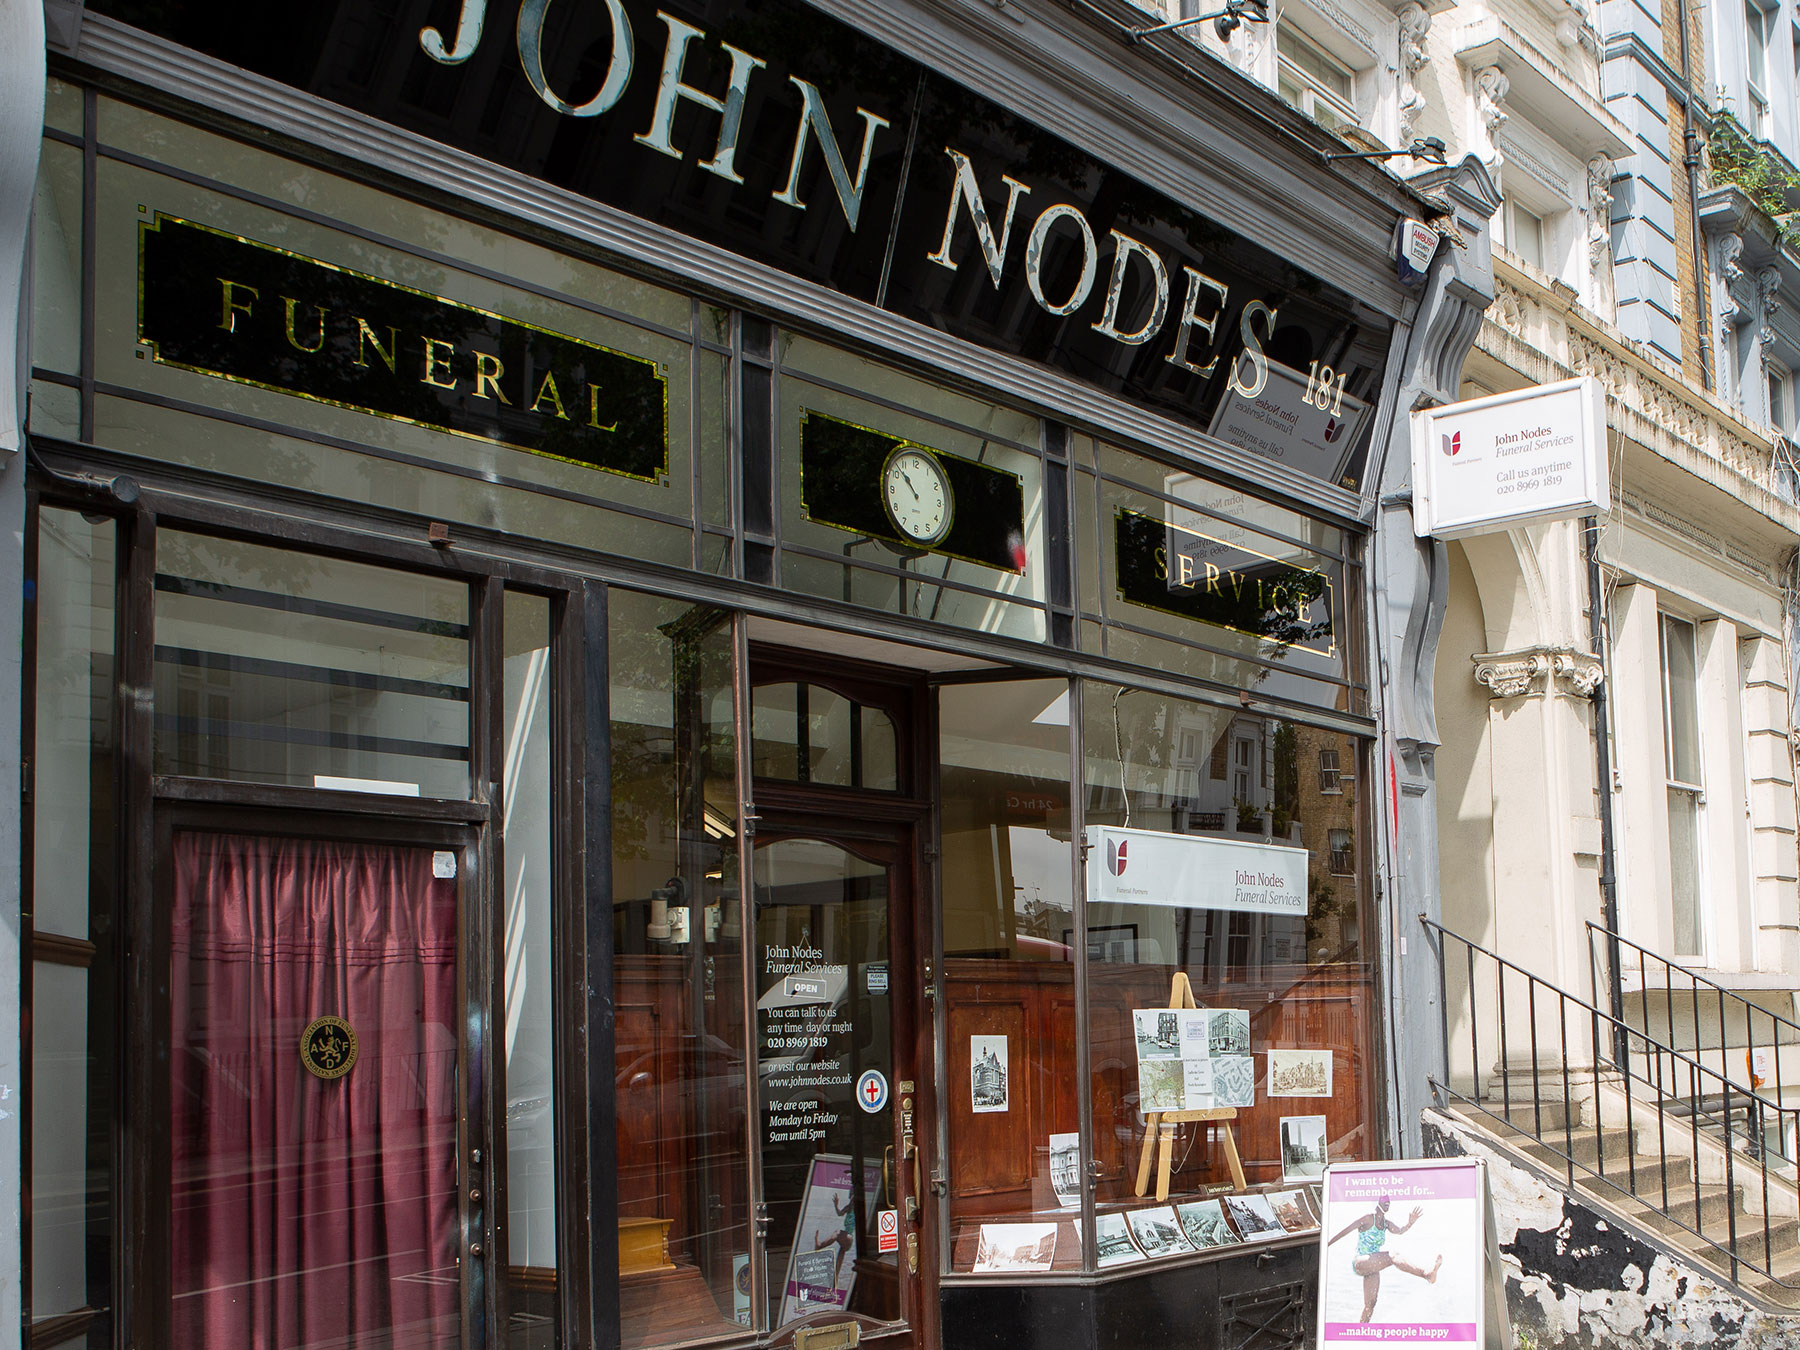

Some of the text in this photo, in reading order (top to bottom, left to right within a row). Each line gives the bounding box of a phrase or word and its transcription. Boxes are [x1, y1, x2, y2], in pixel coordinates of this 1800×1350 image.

[1414, 230, 1436, 247] AMBUSH
[926, 146, 1279, 399] NODES
[1302, 360, 1347, 418] 181
[216, 277, 619, 433] FUNERAL
[1495, 426, 1552, 447] John Nodes
[1496, 434, 1574, 458] Funeral Services
[912, 459, 919, 469] 12
[892, 470, 899, 479] 10
[1496, 460, 1572, 483] Call us anytime
[890, 485, 895, 494] 9
[934, 482, 938, 491] 2
[1496, 475, 1562, 496] 020 8969 1819
[894, 503, 898, 511] 8
[937, 499, 942, 508] 3
[902, 517, 907, 525] 7
[914, 525, 919, 533] 6
[925, 524, 930, 532] 5
[1154, 546, 1312, 624] SERVICE
[1235, 870, 1284, 888] John Nodes
[1235, 888, 1302, 907] Funeral Services
[766, 945, 823, 960] John Nodes
[766, 960, 842, 974] Funeral Services
[794, 983, 818, 993] OPEN
[767, 1007, 836, 1018] You can talk to us
[325, 1026, 333, 1035] N
[767, 1024, 783, 1035] any
[784, 1022, 802, 1033] time
[806, 1022, 820, 1035] day
[832, 1021, 853, 1034] night
[311, 1042, 349, 1053] A F
[767, 1037, 828, 1048] 020 8969 1819
[327, 1059, 334, 1068] D
[768, 1064, 777, 1072] or
[778, 1062, 794, 1072] visit
[810, 1060, 840, 1070] website
[768, 1074, 852, 1088] www.johnnodes.co.uk
[769, 1100, 818, 1112] We are open
[769, 1112, 839, 1127] Monday to Friday
[770, 1128, 826, 1142] 9am until 5pm
[1345, 1176, 1404, 1186] I want to be
[1344, 1185, 1435, 1198] remembered for...
[1339, 1327, 1449, 1339] ...making people happy
